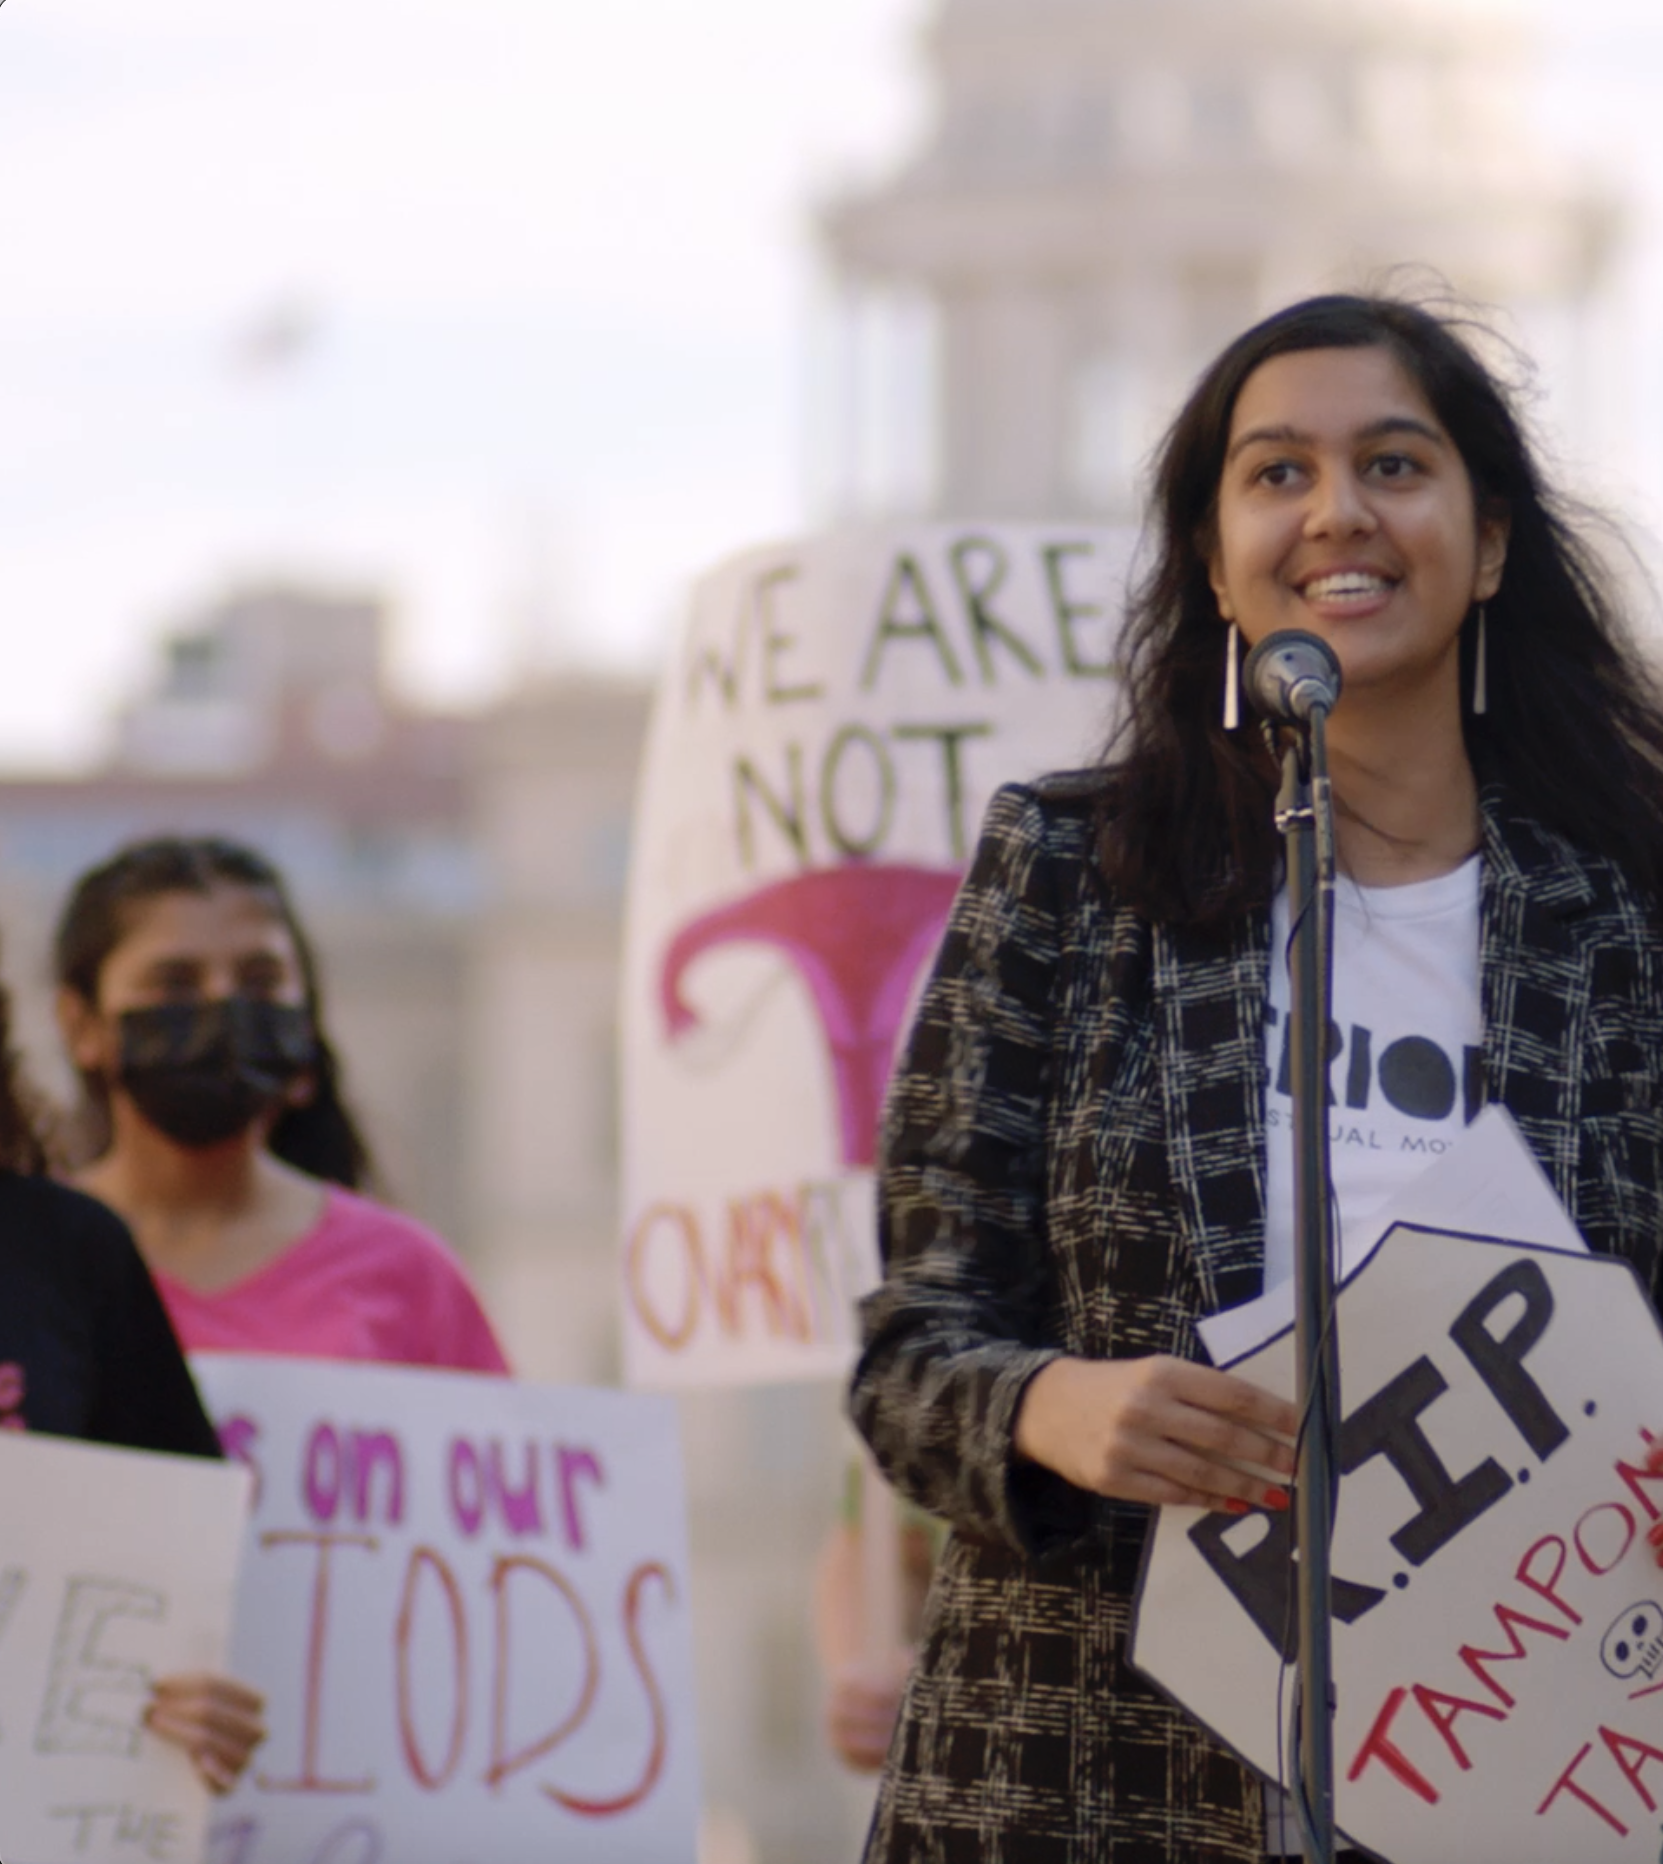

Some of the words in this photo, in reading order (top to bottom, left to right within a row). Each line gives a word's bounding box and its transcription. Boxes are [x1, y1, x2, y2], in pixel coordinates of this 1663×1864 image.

[686, 562, 826, 712] WE
[859, 537, 1113, 693] ARE
[733, 722, 993, 869] NOT
[1401, 1136, 1454, 1155] MO
[305, 1420, 405, 1527] on
[450, 1435, 607, 1553] our
